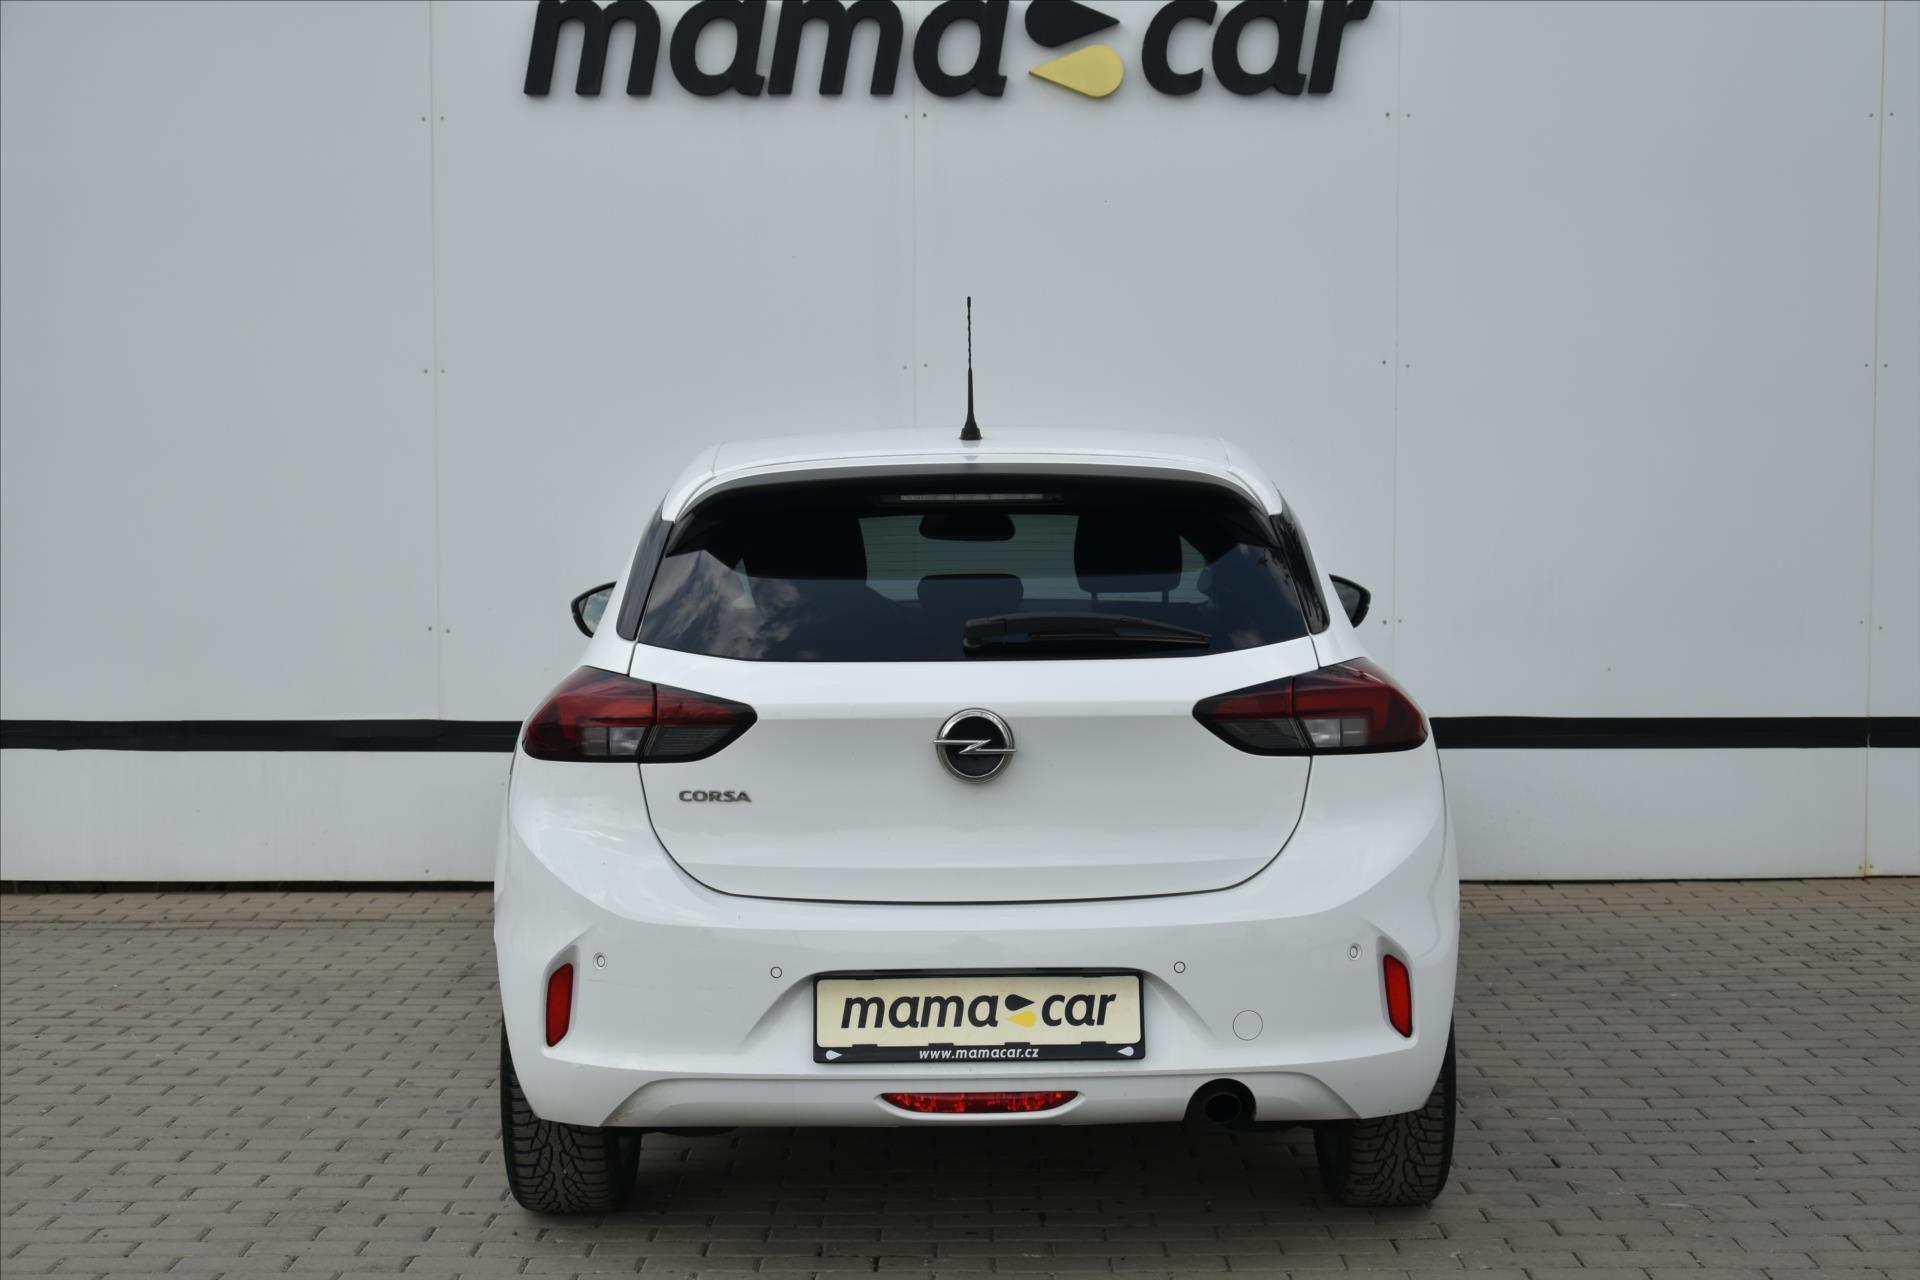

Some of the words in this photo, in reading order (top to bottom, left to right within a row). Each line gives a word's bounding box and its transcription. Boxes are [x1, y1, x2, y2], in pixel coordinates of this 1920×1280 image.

[523, 0, 1008, 97] mama
[1141, 0, 1374, 96] car
[679, 790, 752, 803] CORSA
[841, 994, 999, 1028] mama
[1041, 993, 1117, 1026] car
[919, 1046, 1040, 1060] www.mamacar.cz
